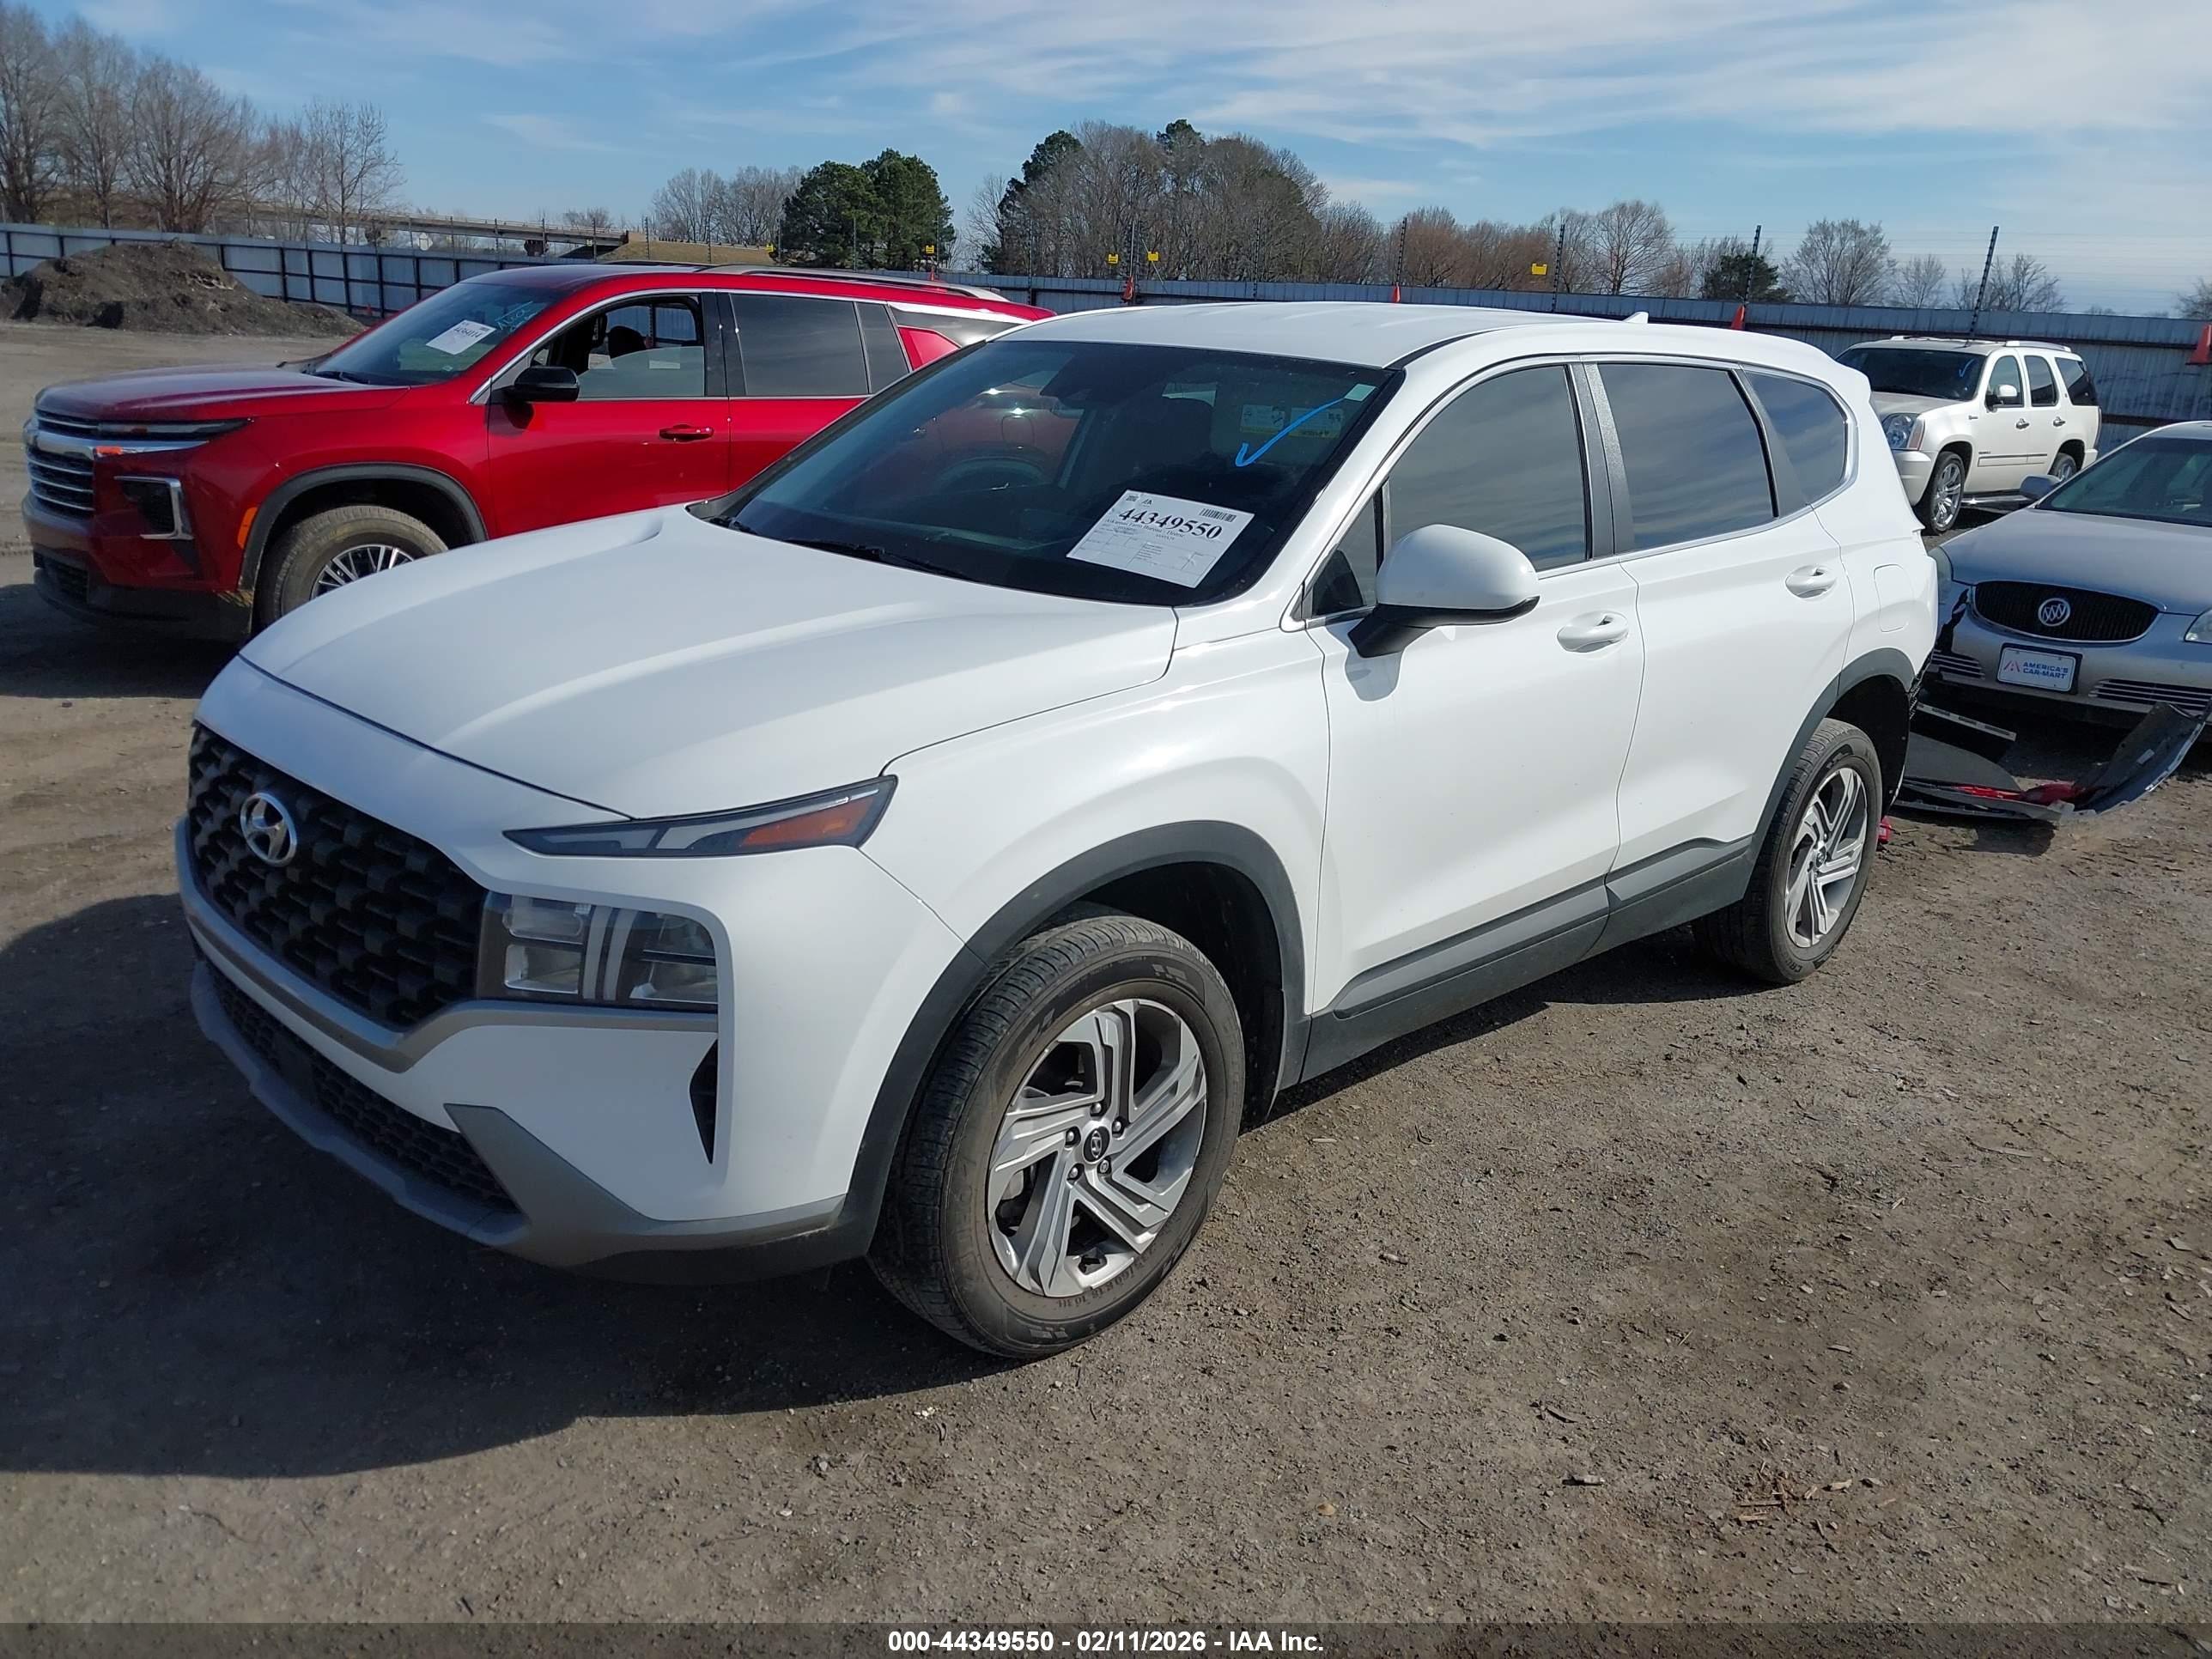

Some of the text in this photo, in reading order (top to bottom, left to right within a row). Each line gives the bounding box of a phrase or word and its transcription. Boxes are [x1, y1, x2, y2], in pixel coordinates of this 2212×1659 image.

[1119, 508, 1223, 539] 44349550
[2023, 662, 2069, 673] AMERICA'S
[2023, 668, 2066, 679] CAR-MART
